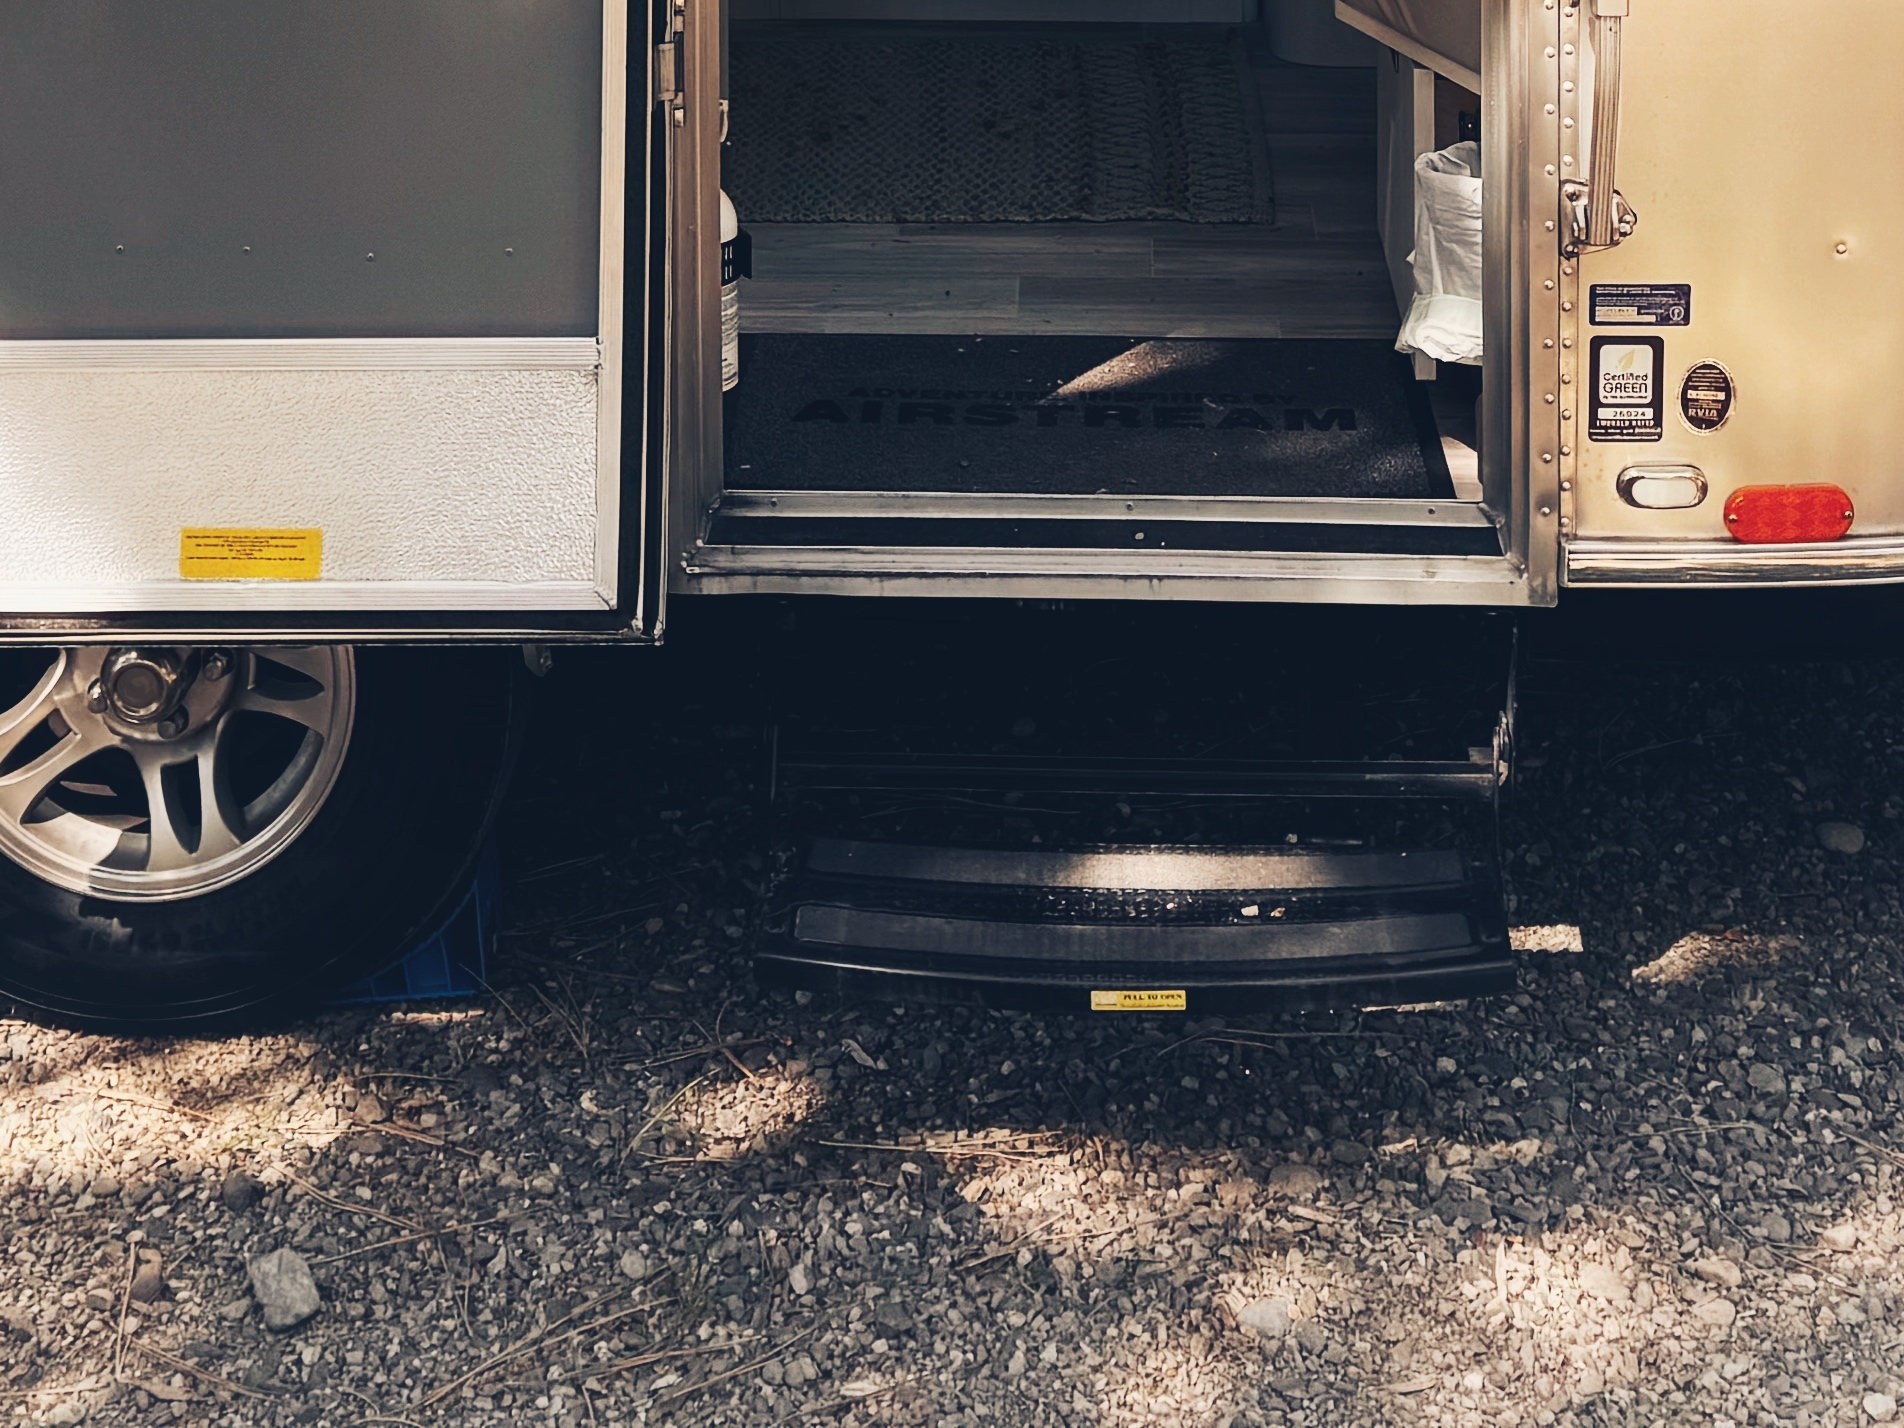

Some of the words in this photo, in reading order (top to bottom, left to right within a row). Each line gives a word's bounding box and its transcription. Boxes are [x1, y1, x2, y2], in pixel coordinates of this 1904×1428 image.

[1602, 372, 1649, 382] Certified
[1602, 382, 1649, 394] GREEN
[790, 398, 1358, 432] AIRSTREAM
